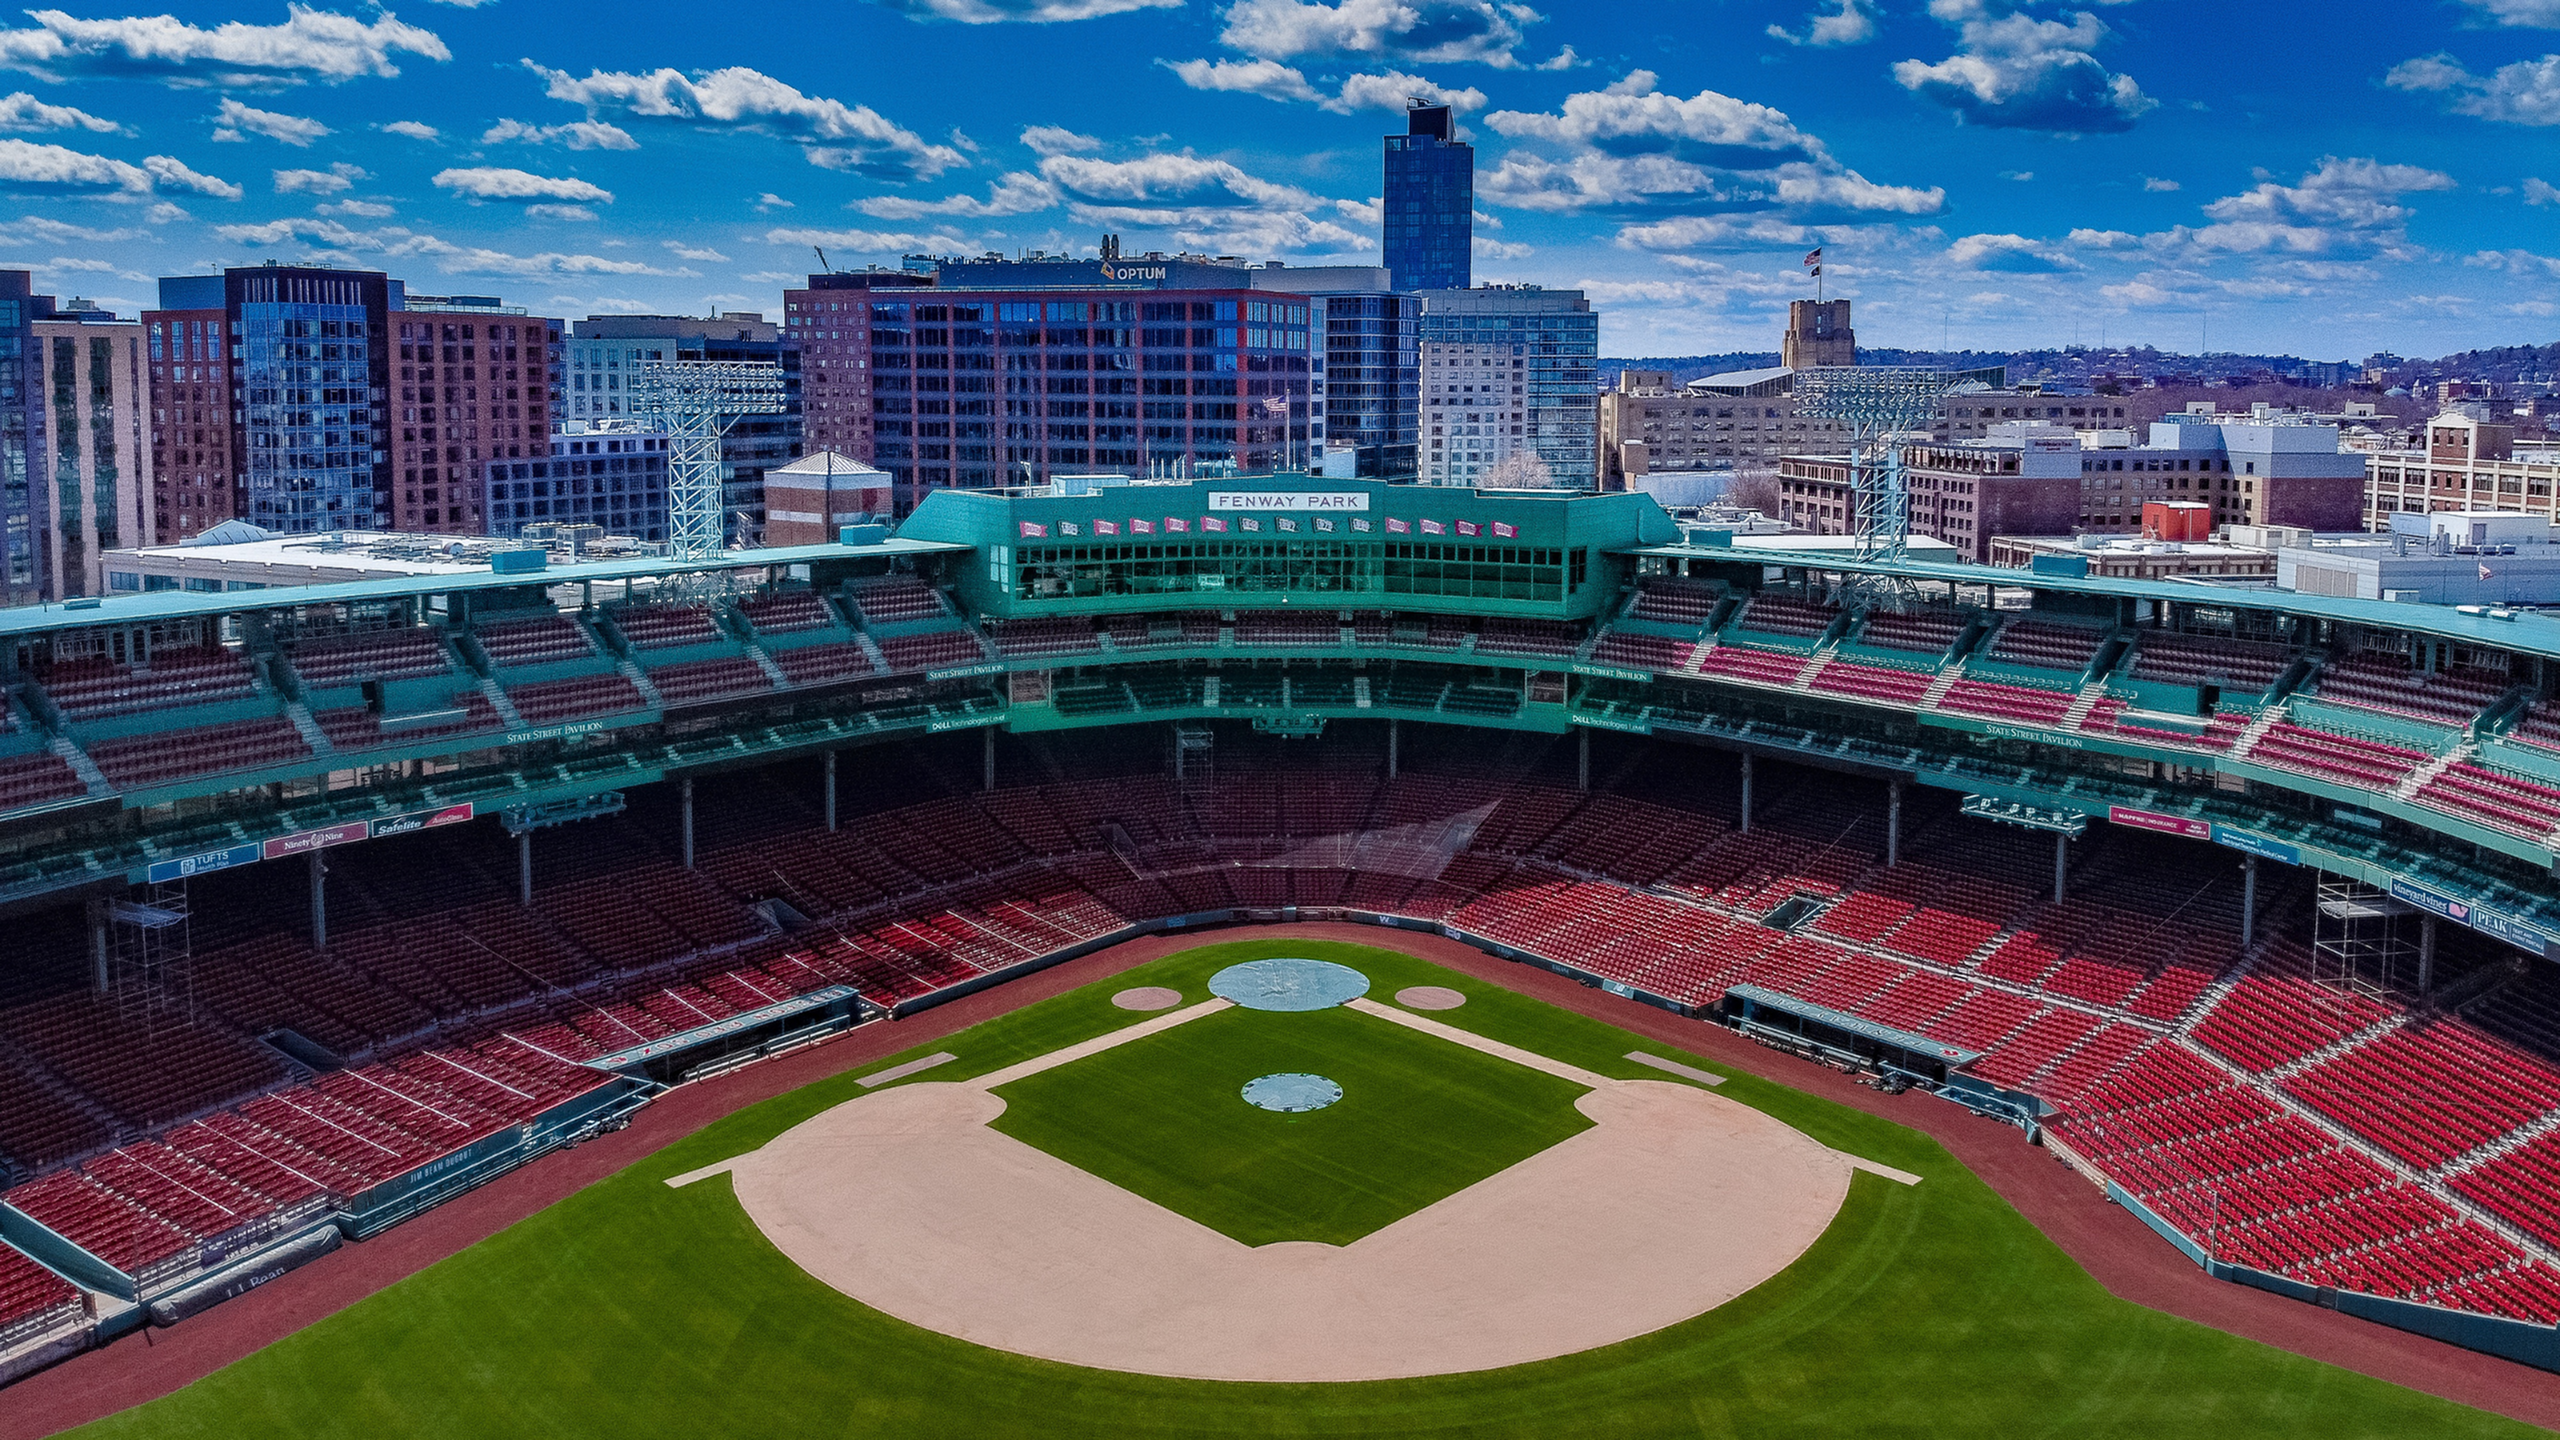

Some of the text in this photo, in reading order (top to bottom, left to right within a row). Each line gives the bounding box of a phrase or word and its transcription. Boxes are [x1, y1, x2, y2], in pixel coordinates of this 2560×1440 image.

[1117, 267, 1166, 280] OPTUM
[1220, 496, 1359, 508] FENWAY PARK
[929, 664, 1004, 679] STATE STREET PAVILION
[1572, 664, 1647, 681] STATE STREET PAVILION
[932, 713, 1005, 731] DELL Technologies Level
[1572, 715, 1645, 732] DELL Technologies Level
[507, 722, 603, 744] STATE STREET PAVILION
[1986, 724, 2083, 748] STATE STREET PAVILION
[378, 821, 422, 834] Safelite
[2147, 818, 2178, 829] INSURANCE
[284, 838, 311, 850] Ninety
[324, 832, 344, 841] Nine
[196, 851, 229, 865] TUFTS
[2393, 882, 2447, 910] vineyard vines
[2477, 911, 2508, 933] PEAK
[410, 1149, 472, 1183] JIM BEAM DUGOUT
